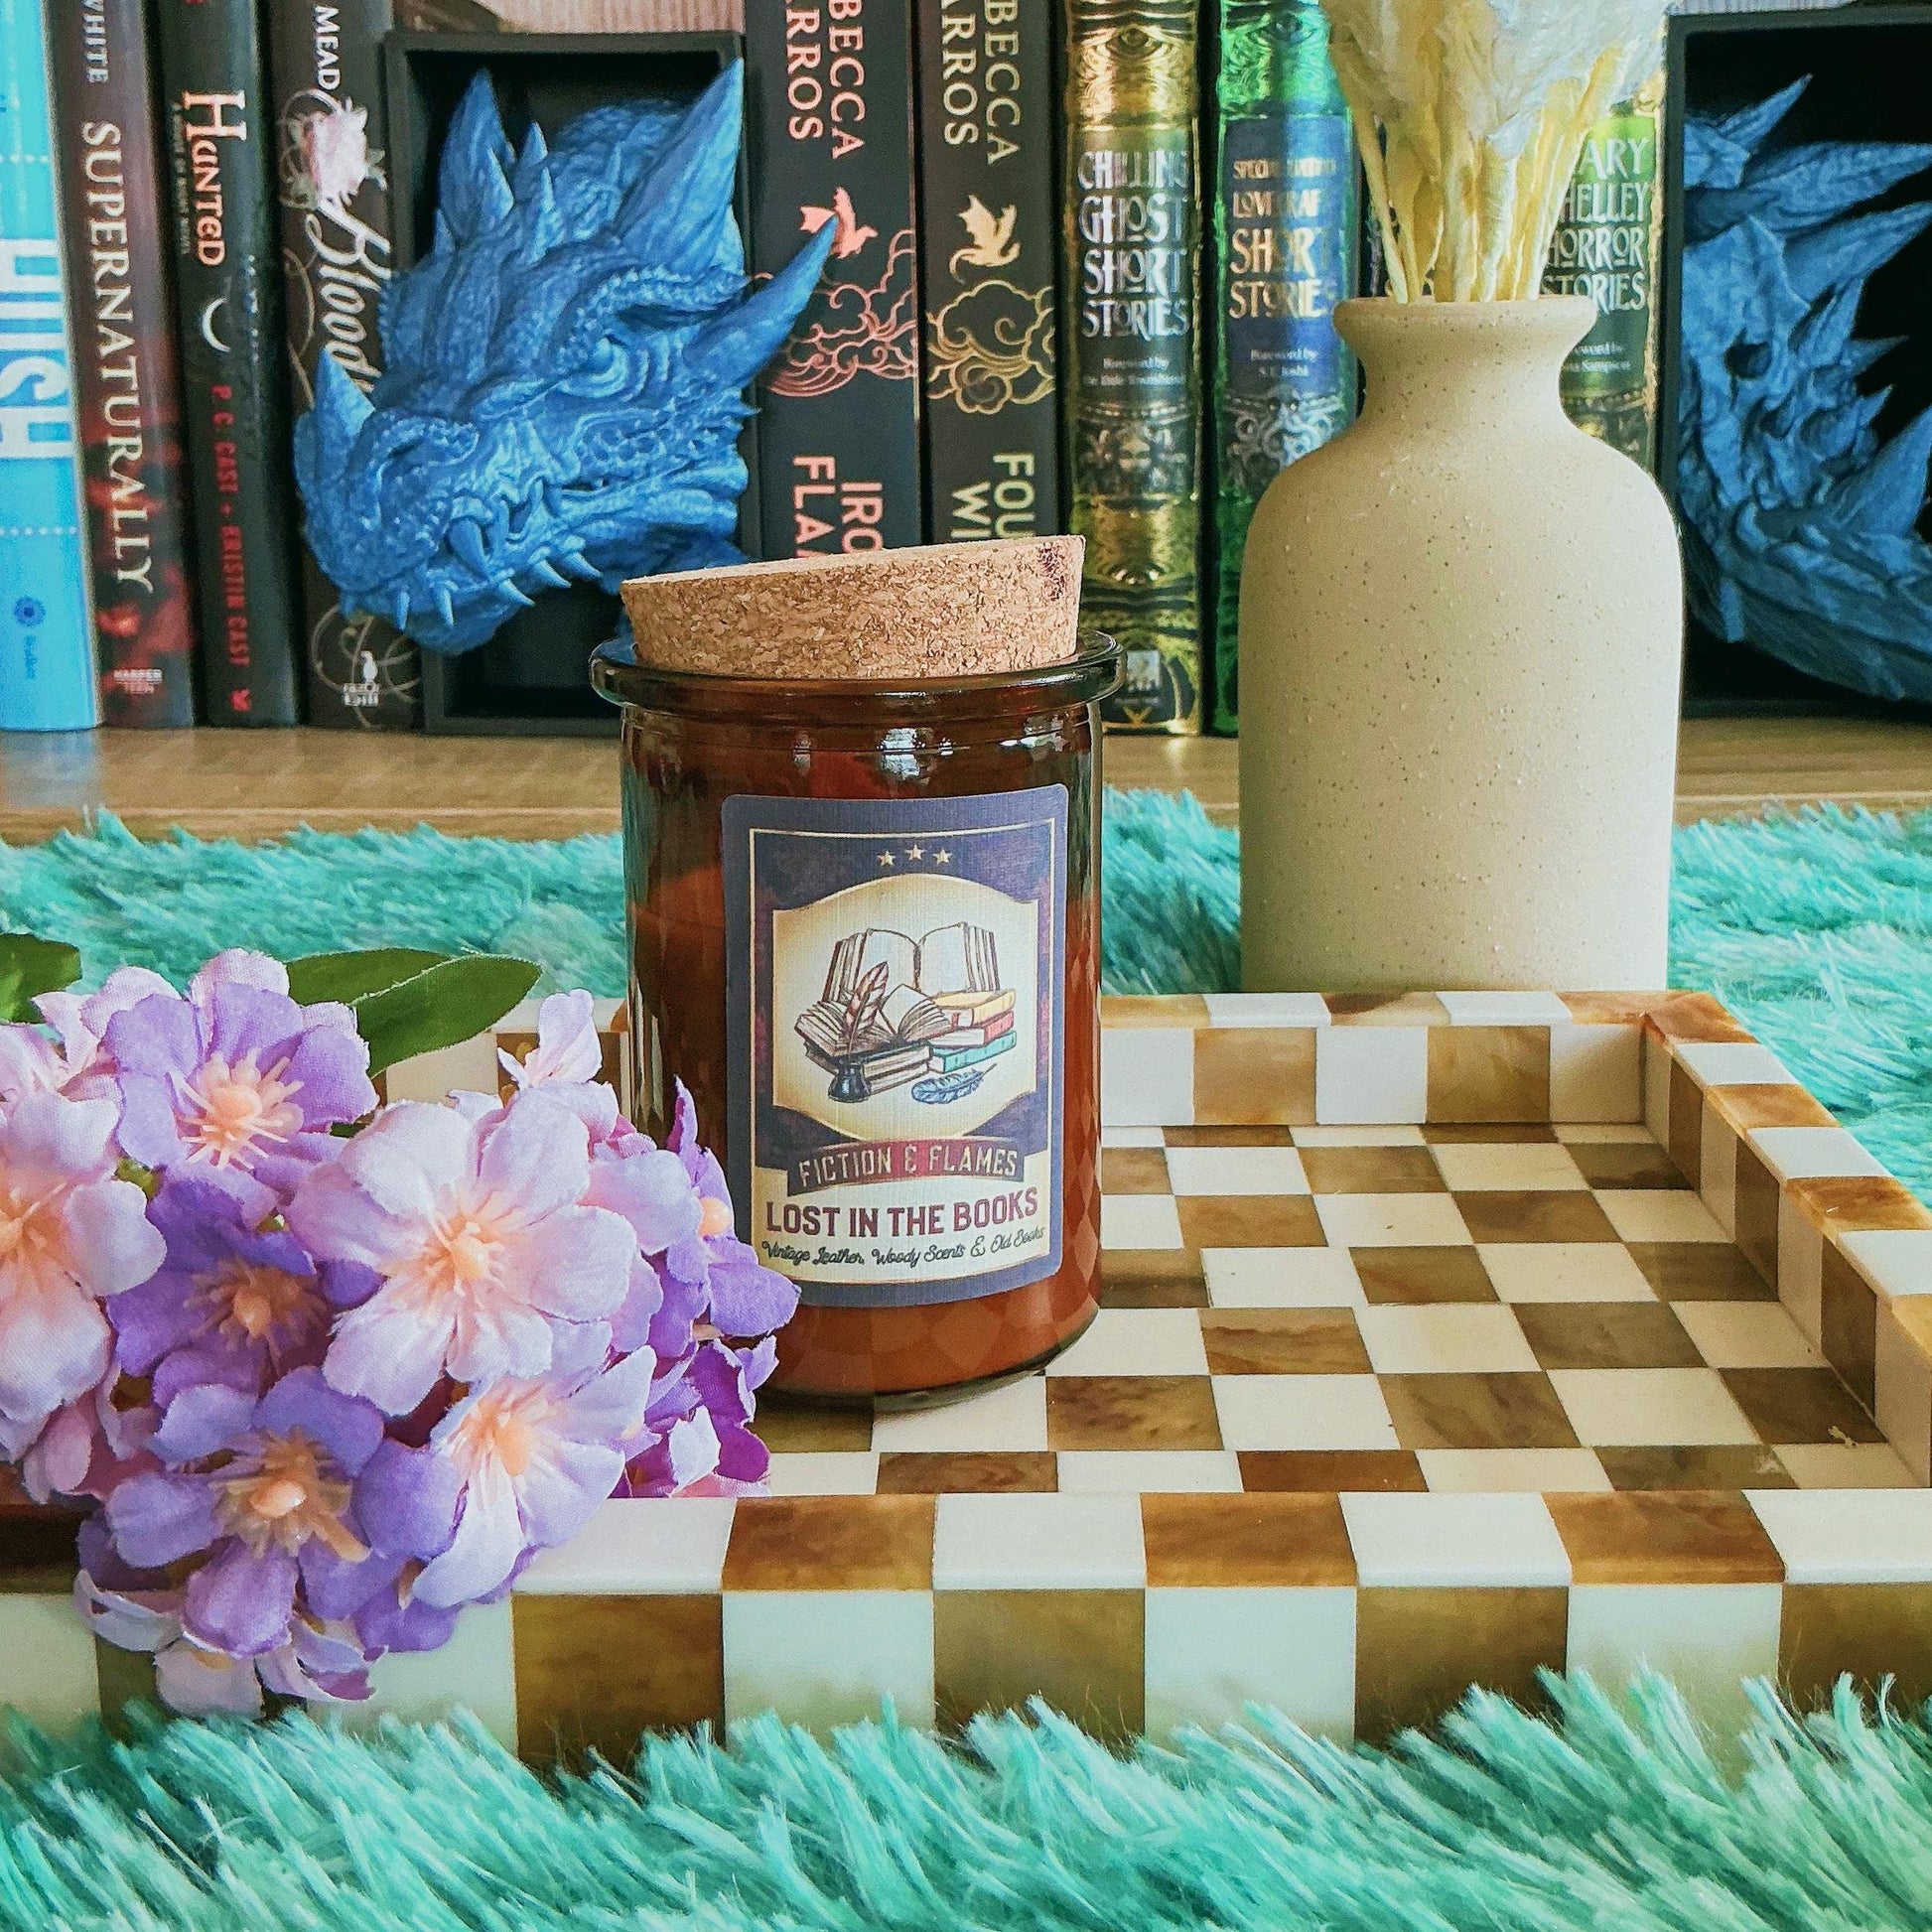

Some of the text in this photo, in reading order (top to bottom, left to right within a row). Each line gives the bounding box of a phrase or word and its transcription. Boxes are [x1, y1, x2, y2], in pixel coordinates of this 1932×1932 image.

[315, 5, 341, 91] MEAD
[941, 0, 979, 145] RROS
[1578, 137, 1649, 180] ARY
[1079, 193, 1188, 244] GHOST
[1561, 182, 1650, 224] HELLEY
[1082, 248, 1187, 298] SHORT
[1082, 297, 1190, 341] STORIES
[81, 121, 153, 594] SUPERNATURALLY
[792, 456, 836, 558] FLA
[798, 1144, 1019, 1187] FICTION & FLAMES
[765, 1186, 1038, 1238] LOST IN THE BOOKS
[761, 1240, 810, 1266] Vintage
[872, 1244, 921, 1268] Woody
[923, 1241, 966, 1262] Scents
[970, 1235, 986, 1258] &
[991, 1234, 1013, 1254] Old
[1014, 1225, 1046, 1248] Books
